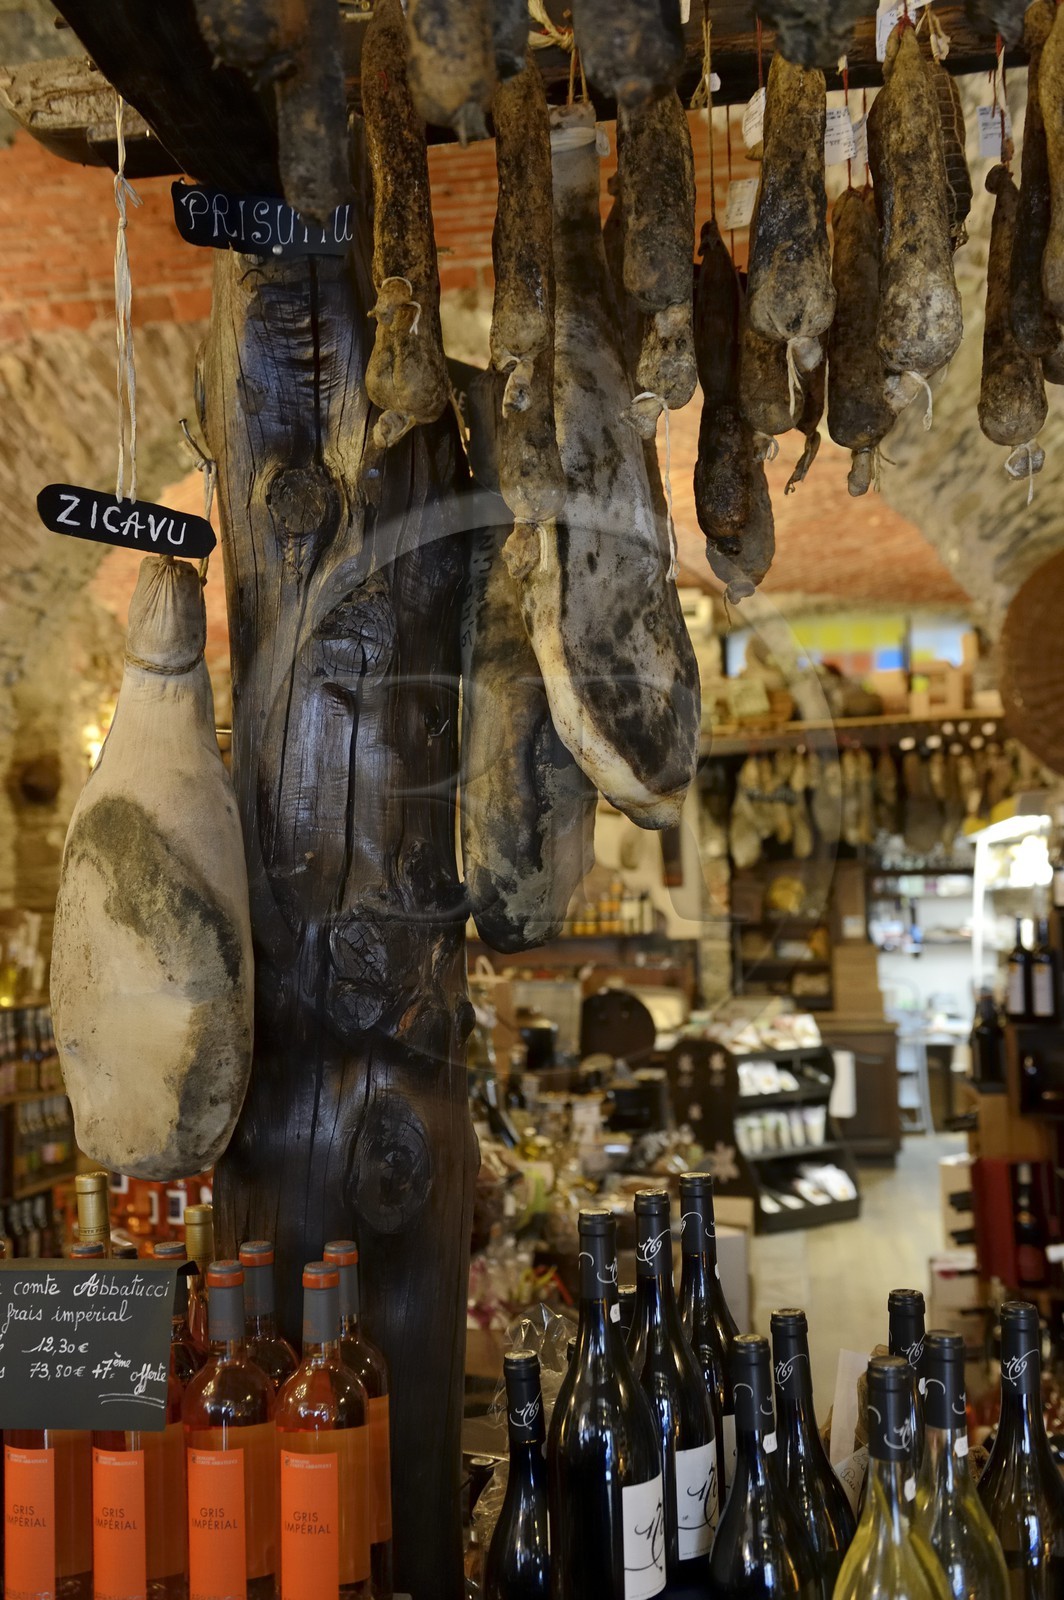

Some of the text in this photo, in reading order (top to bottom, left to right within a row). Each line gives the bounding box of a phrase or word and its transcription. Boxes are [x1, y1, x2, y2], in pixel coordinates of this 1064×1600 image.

[56, 493, 187, 546] ZICAVU
[14, 1273, 61, 1295] comte
[73, 1273, 170, 1297] Abbatucci
[51, 1300, 133, 1331] impérial
[130, 1362, 167, 1396] offerte
[13, 1504, 35, 1516] GRIS
[102, 1507, 125, 1518] GRIS
[200, 1507, 225, 1518] GRIS
[192, 1517, 239, 1530] IMPÉRIAL
[293, 1511, 319, 1523] GRIS
[284, 1521, 332, 1535] IMPÉRIAL
